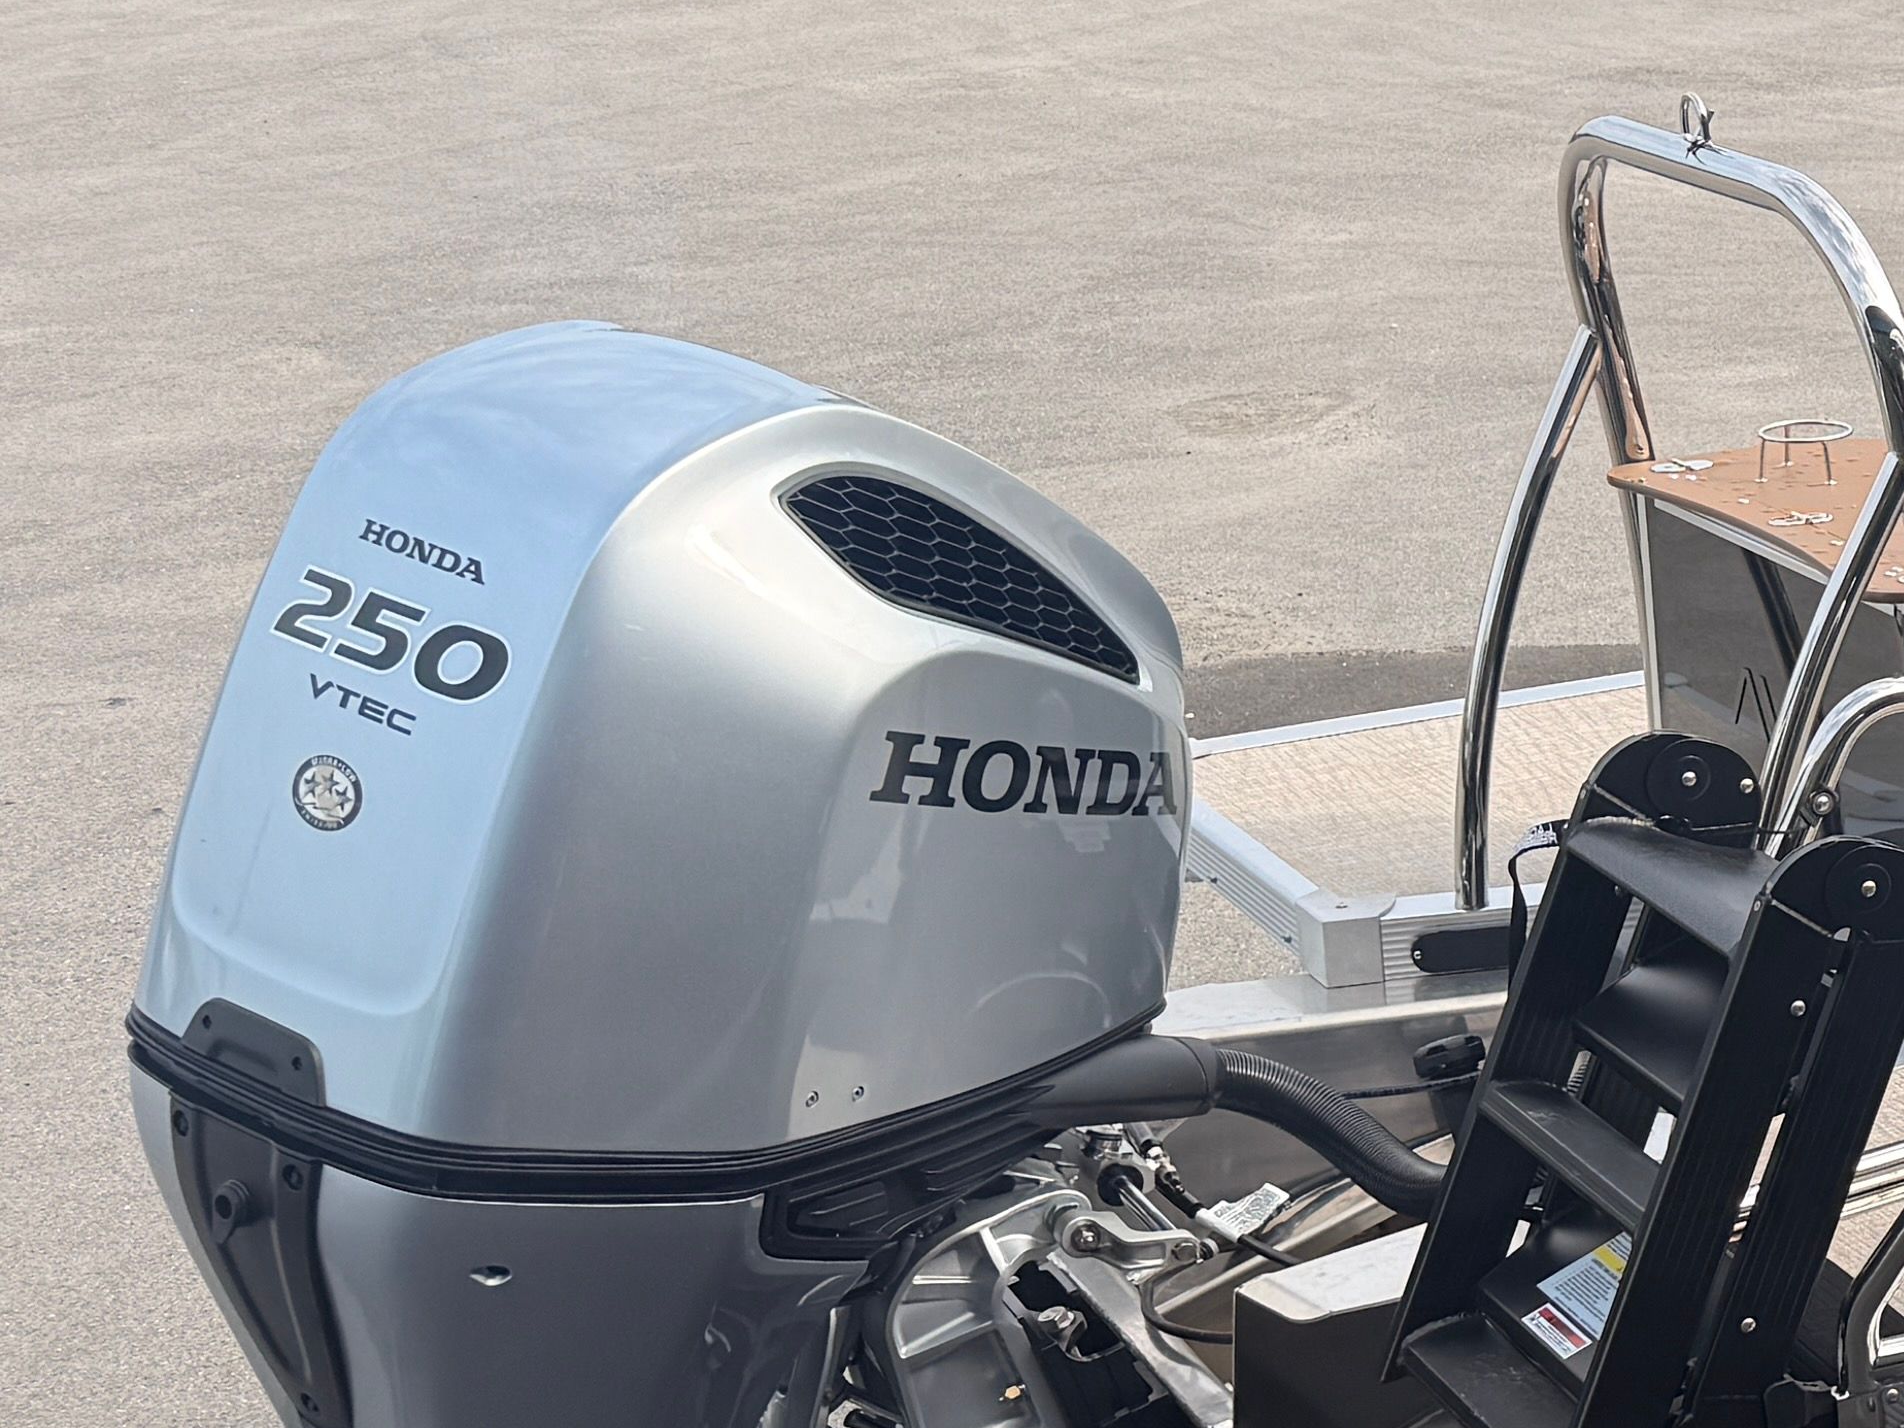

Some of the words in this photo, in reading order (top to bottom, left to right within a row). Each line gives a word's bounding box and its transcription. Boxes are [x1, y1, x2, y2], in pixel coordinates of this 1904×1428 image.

[359, 518, 485, 585] HONDA
[271, 566, 511, 704] 250
[310, 672, 417, 736] VTEC
[869, 730, 1178, 816] HONDA
